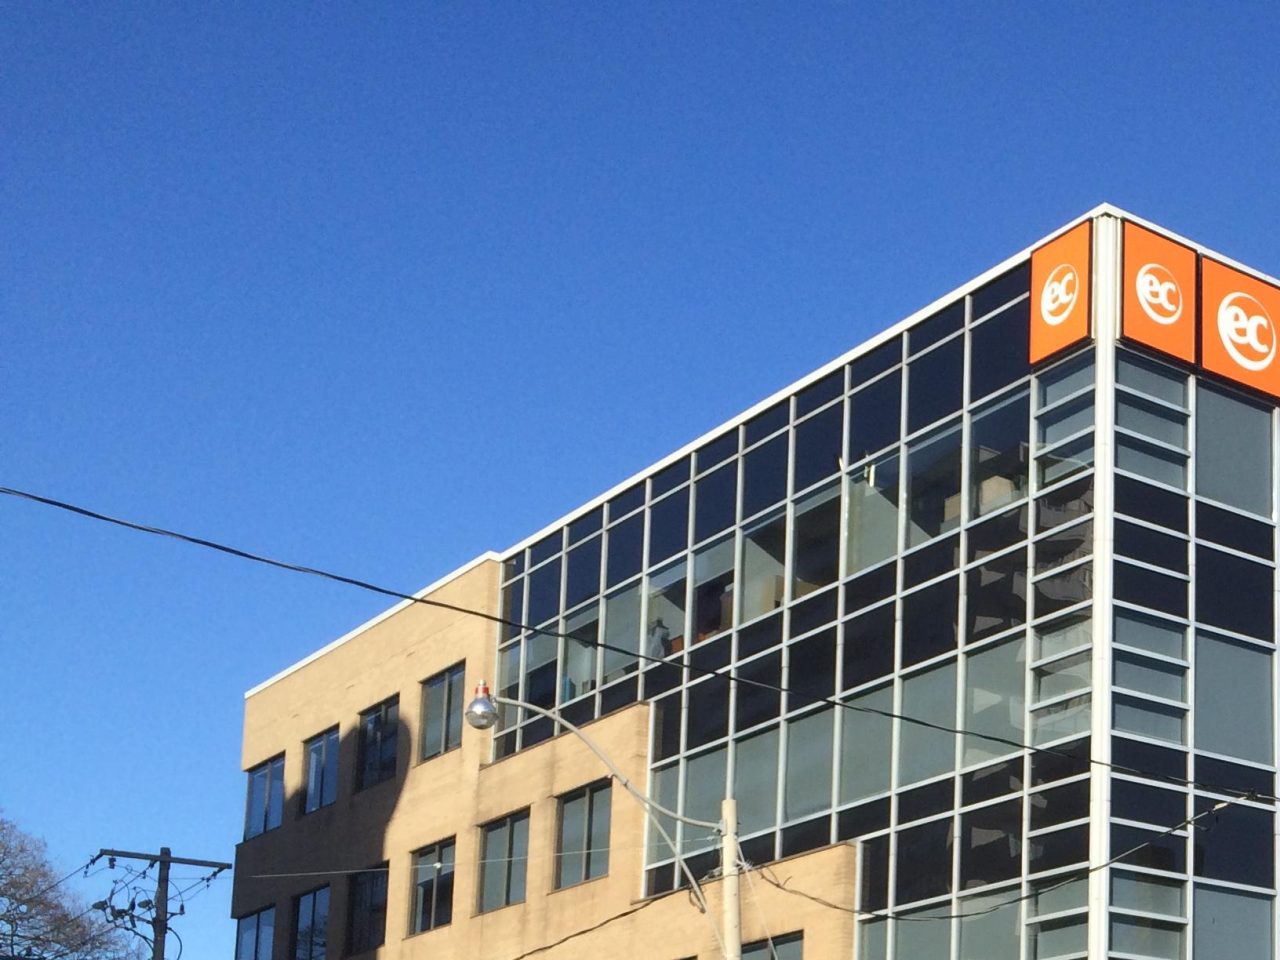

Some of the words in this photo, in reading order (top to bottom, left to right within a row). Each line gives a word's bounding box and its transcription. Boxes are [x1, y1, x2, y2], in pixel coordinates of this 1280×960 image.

[1045, 271, 1075, 311] ec
[1140, 269, 1178, 313] ec
[1222, 302, 1272, 356] ec
